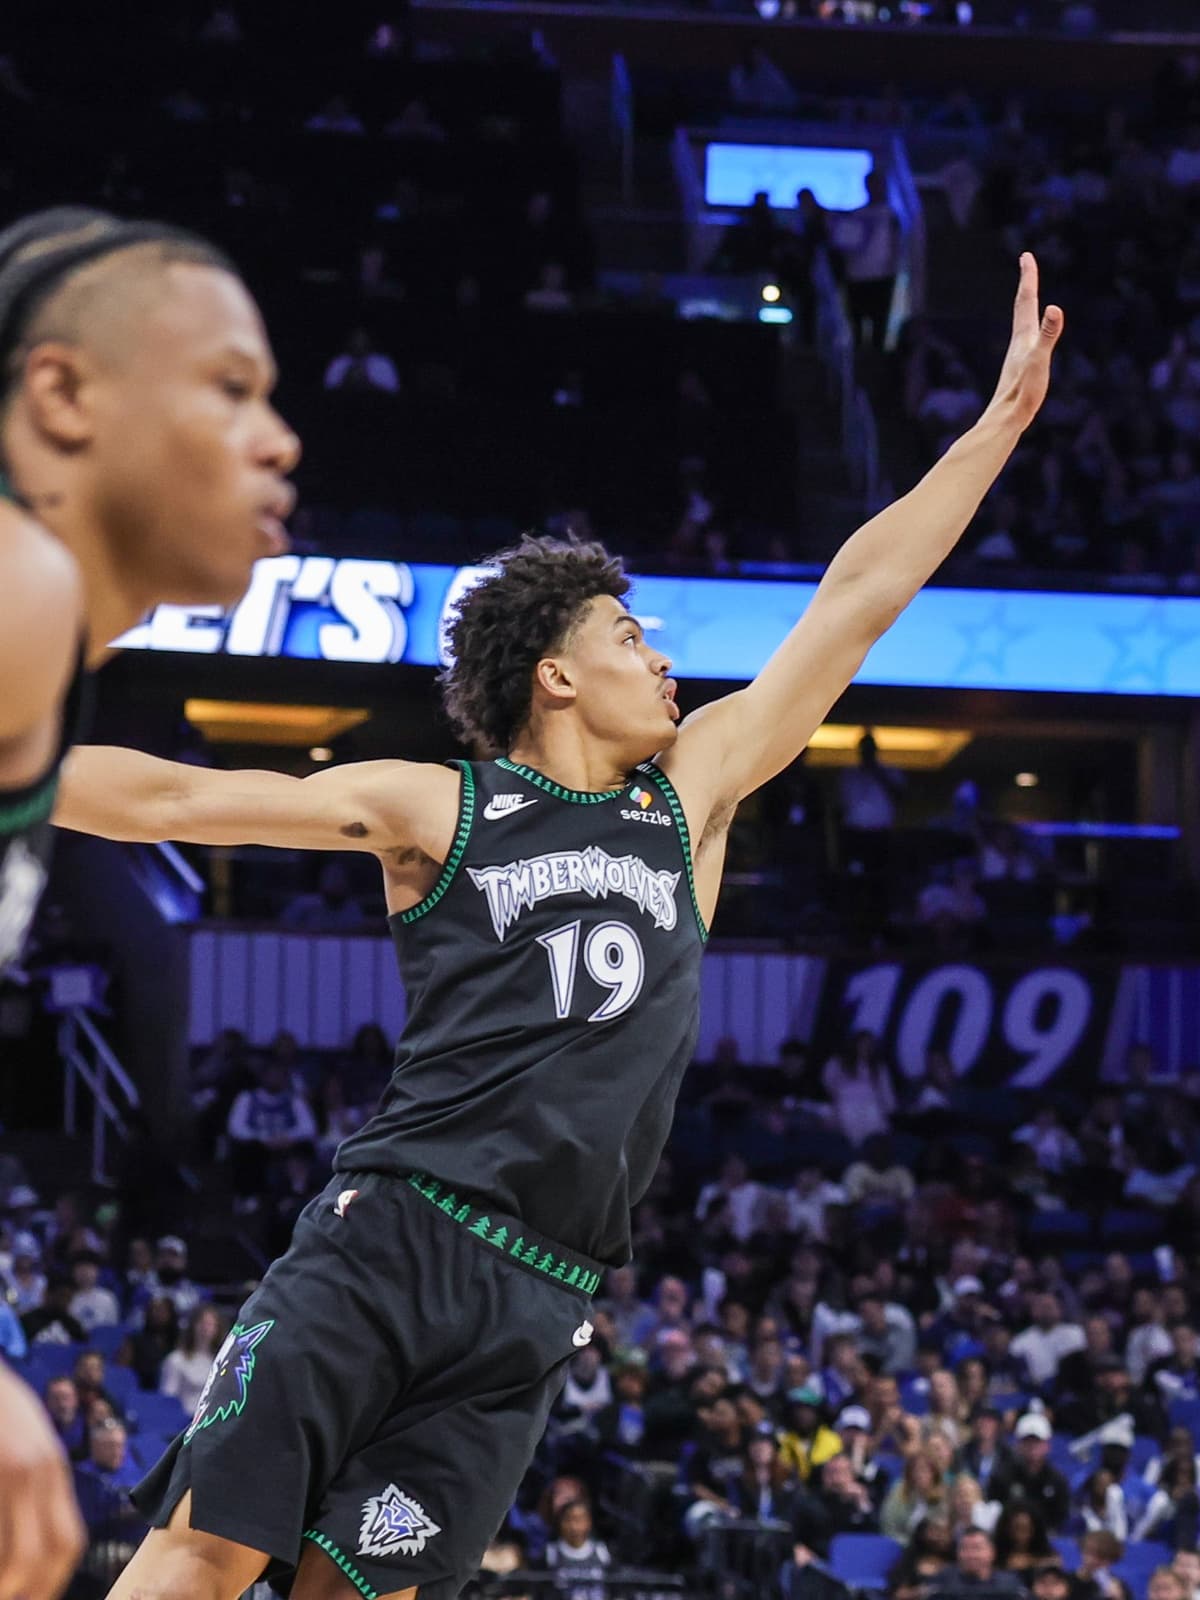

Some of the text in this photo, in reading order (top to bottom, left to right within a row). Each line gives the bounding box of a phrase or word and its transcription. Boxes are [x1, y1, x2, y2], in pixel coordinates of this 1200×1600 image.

[492, 793, 525, 809] NIKE
[620, 809, 672, 827] sezzle
[466, 846, 682, 943] TIMBERWOLVES
[535, 919, 645, 1022] 19
[845, 963, 1093, 1089] 109
